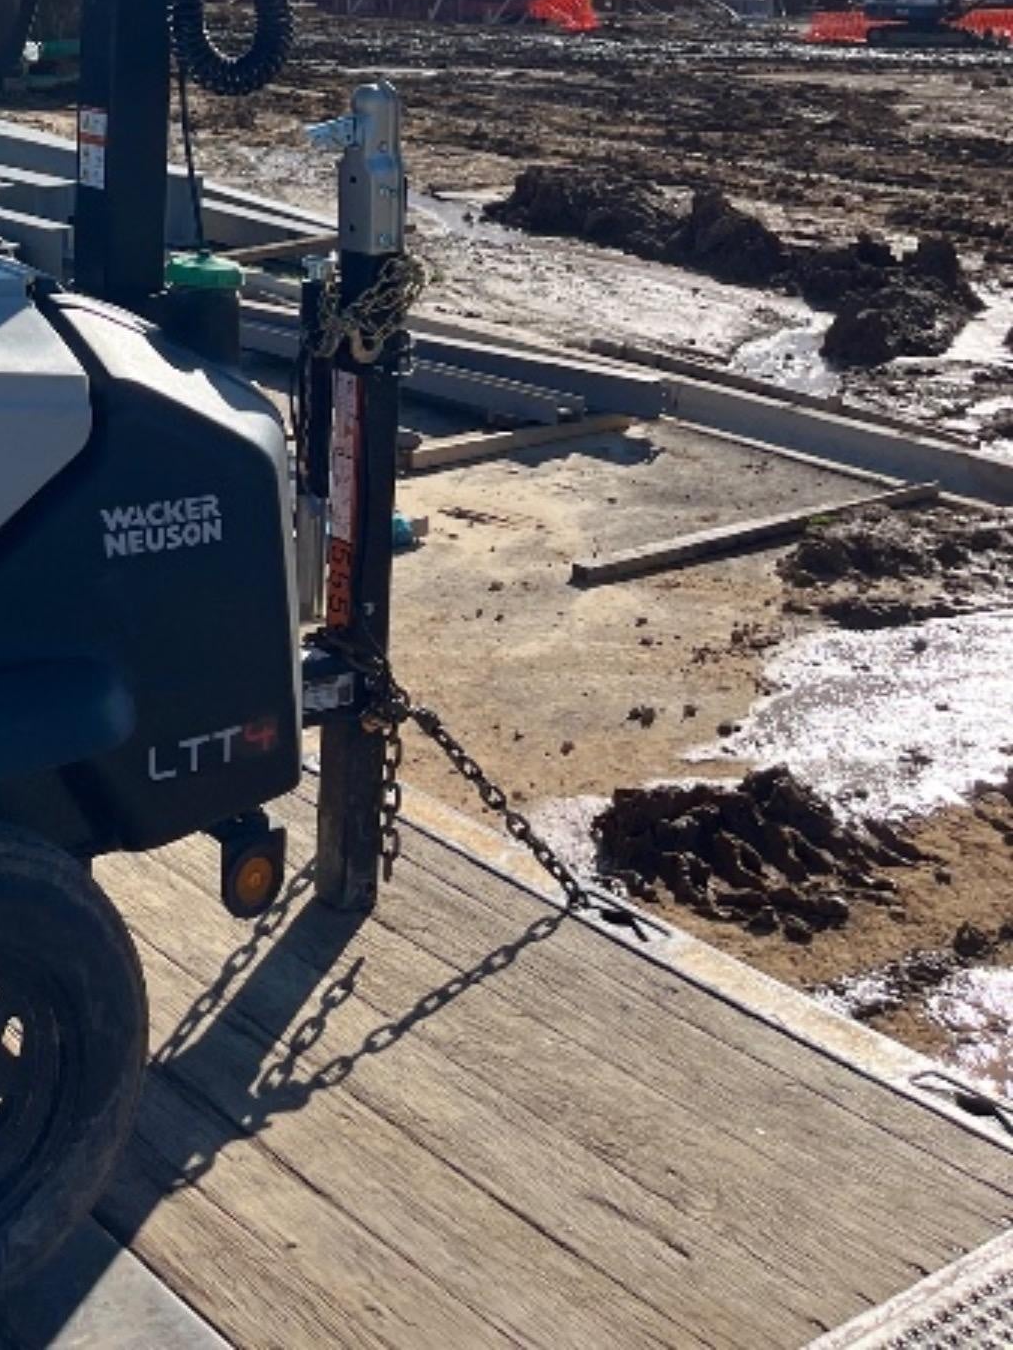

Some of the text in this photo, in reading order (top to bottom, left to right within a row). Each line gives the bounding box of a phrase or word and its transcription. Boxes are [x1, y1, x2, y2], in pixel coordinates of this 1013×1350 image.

[100, 495, 223, 531] WACKER
[103, 518, 223, 559] NEUSON
[148, 721, 278, 781] LTT4
